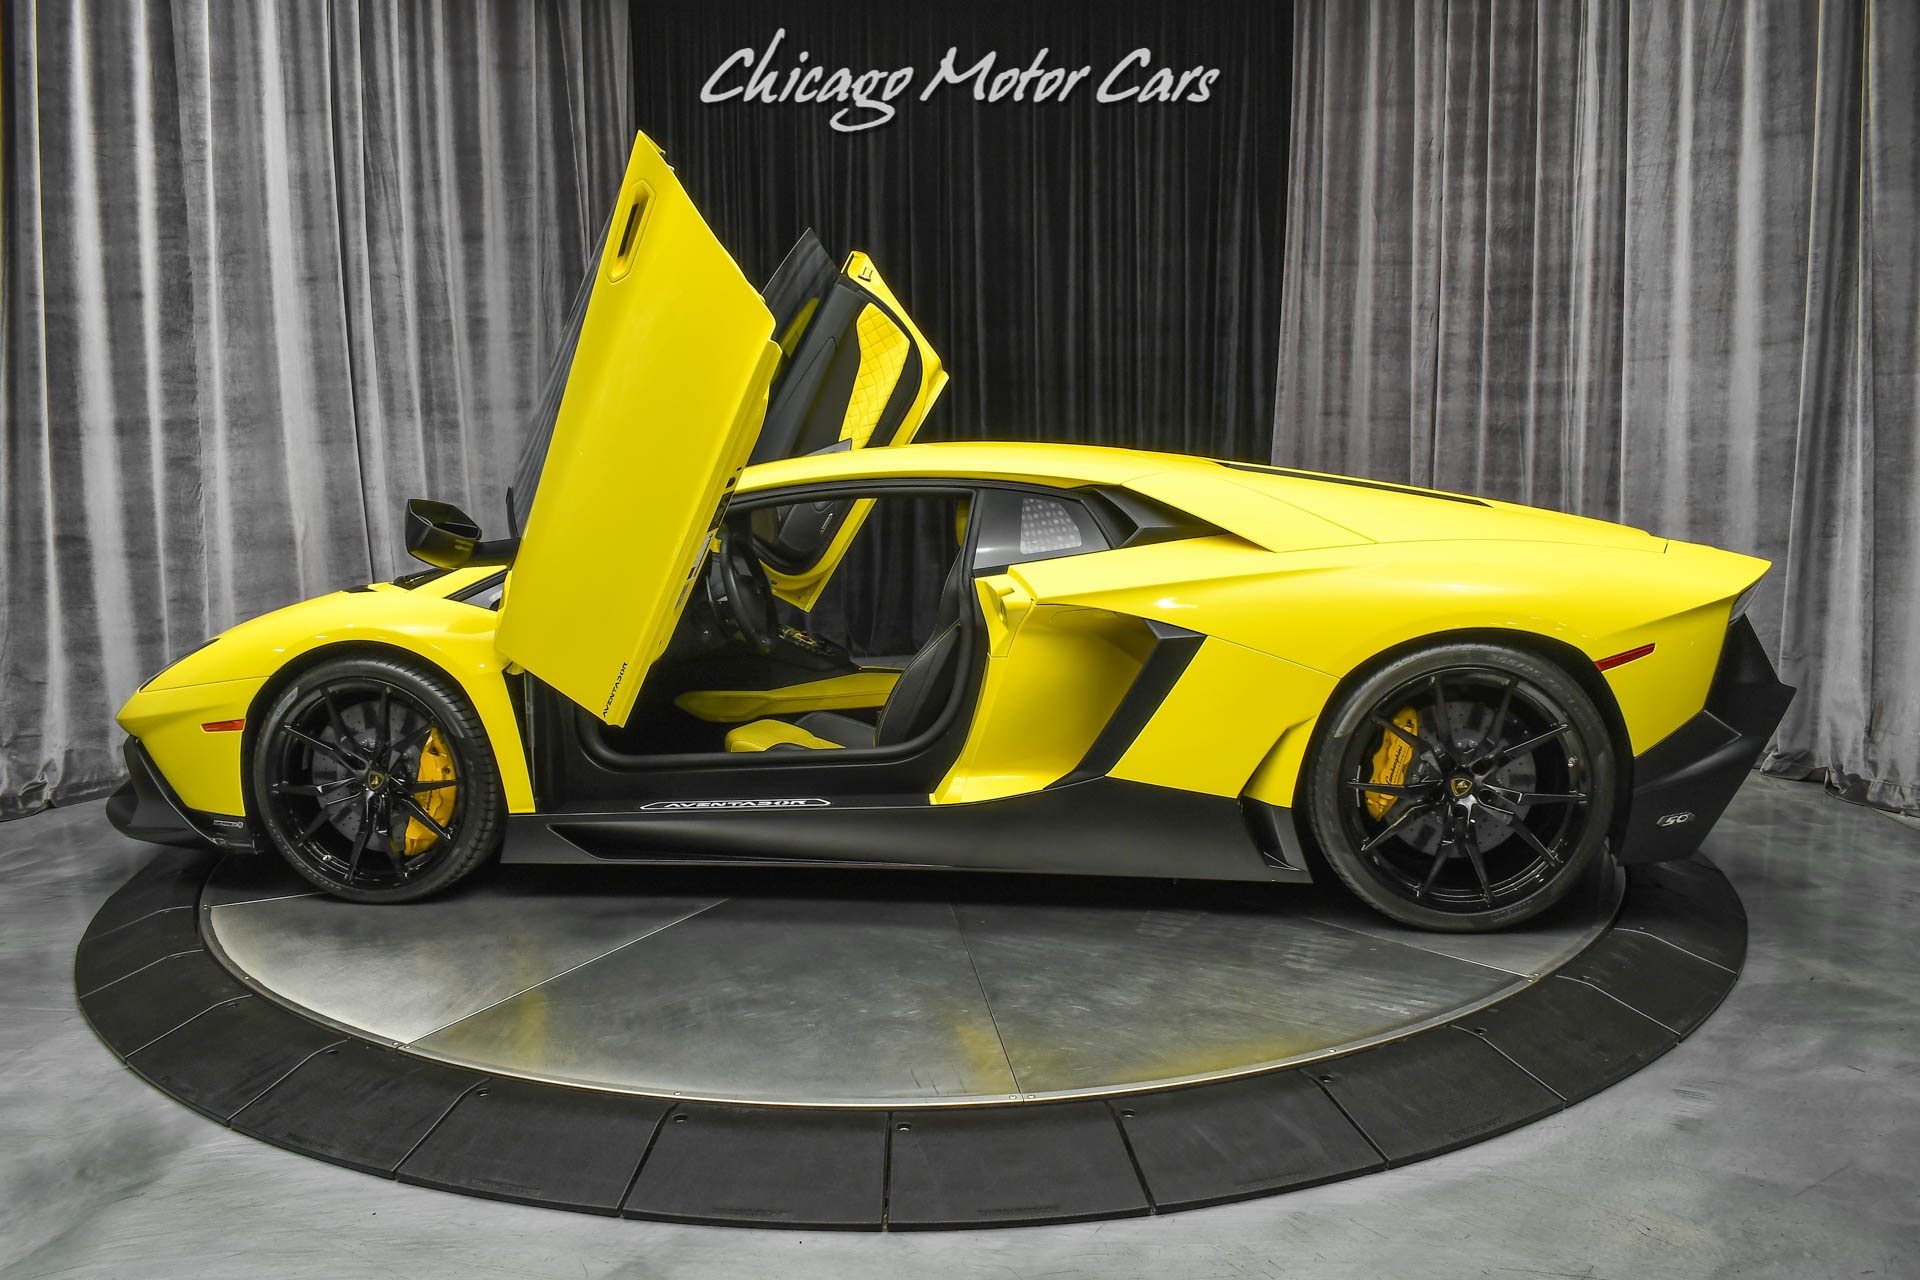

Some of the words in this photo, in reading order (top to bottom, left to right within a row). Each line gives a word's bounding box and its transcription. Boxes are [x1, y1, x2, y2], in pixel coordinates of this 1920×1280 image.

[700, 28, 913, 132] Chicago
[921, 47, 1091, 102] Motor
[1096, 48, 1220, 103] Cars
[602, 662, 628, 718] AVENTADOR
[664, 800, 808, 809] AVENTADOR
